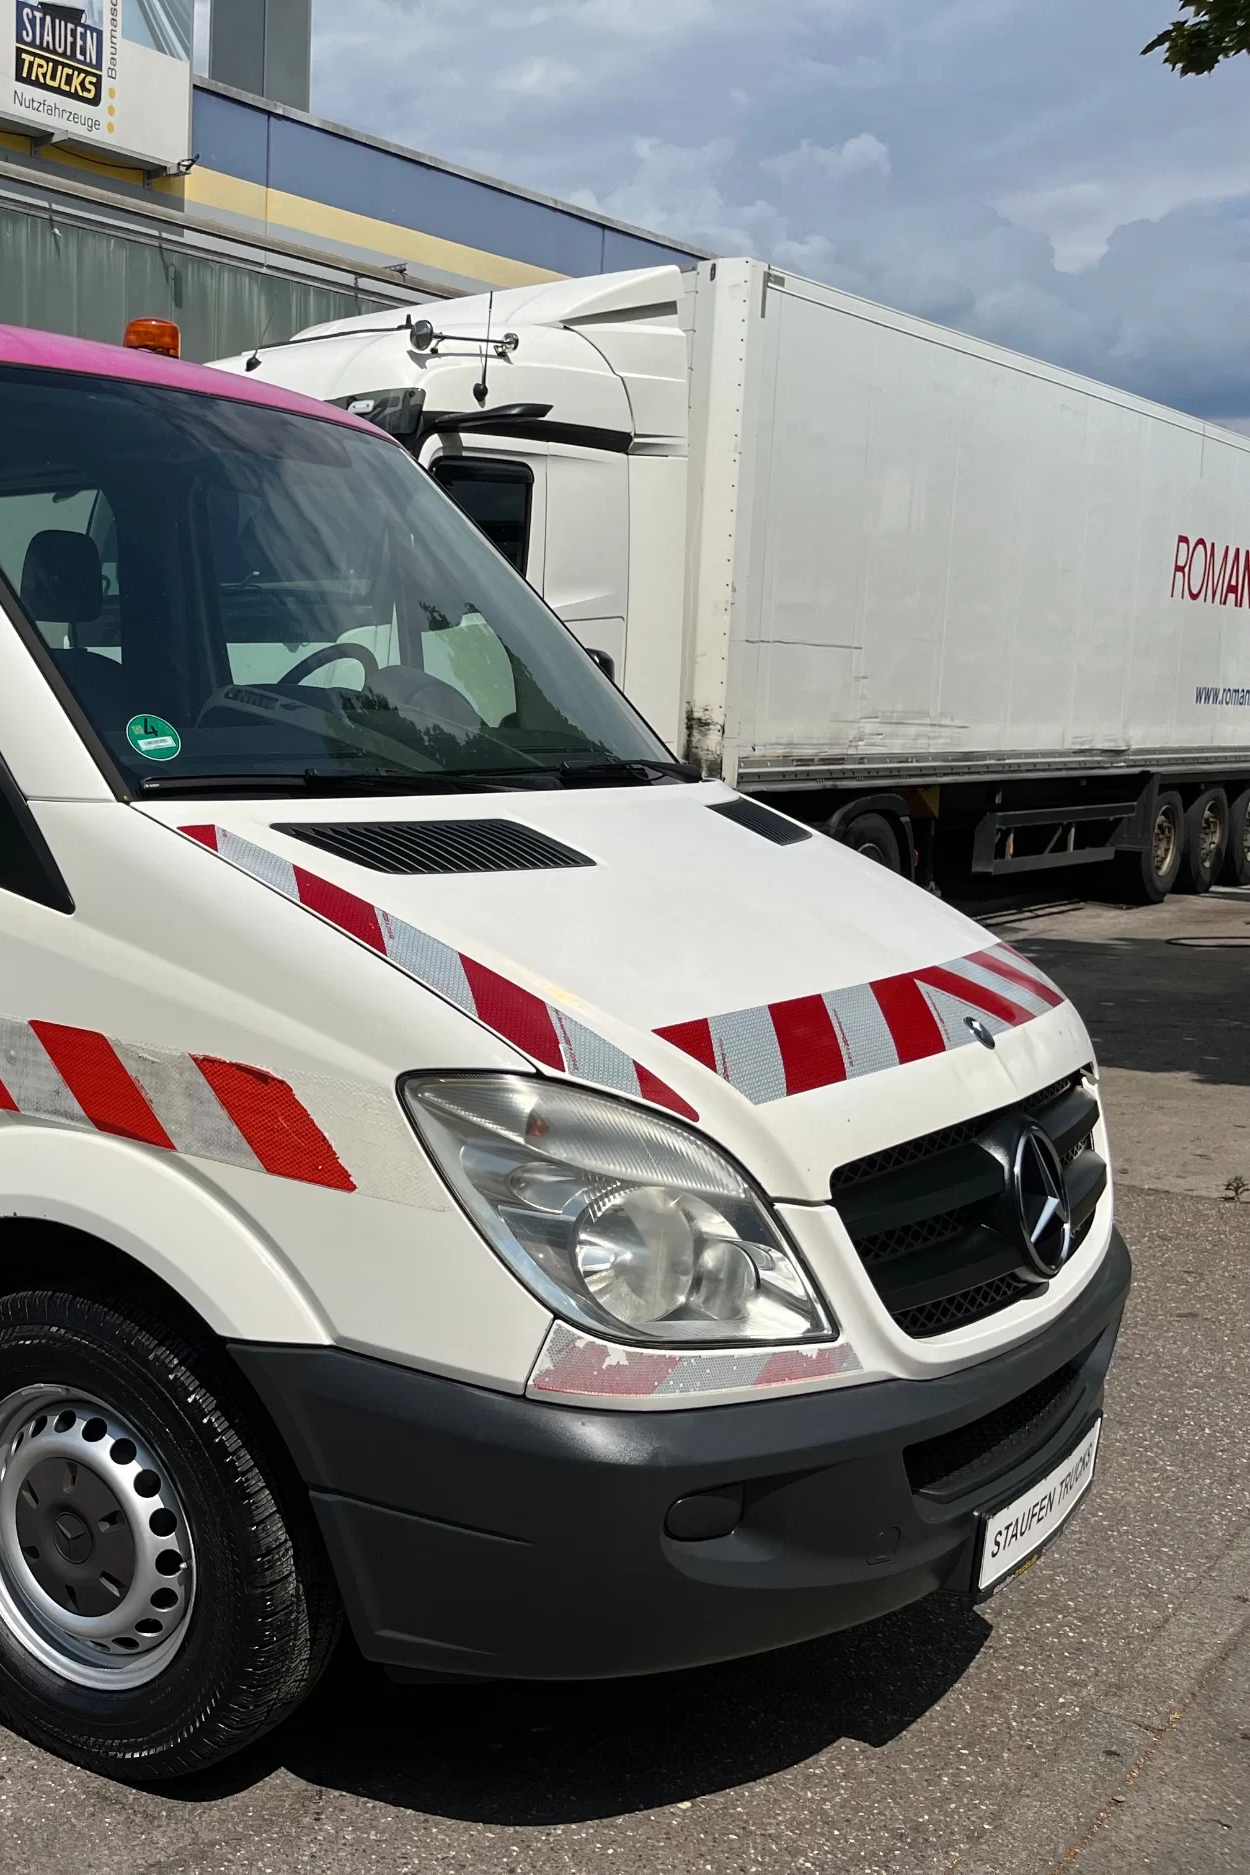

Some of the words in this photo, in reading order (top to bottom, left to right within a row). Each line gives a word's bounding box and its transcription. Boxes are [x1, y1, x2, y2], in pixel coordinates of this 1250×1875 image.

[22, 7, 97, 65] STAUFEN
[21, 53, 97, 99] TRUCKS
[13, 90, 101, 132] Nutzfahrzeuge
[144, 718, 159, 737] 4
[991, 1487, 1056, 1558] STAUFEN
[1058, 1442, 1092, 1505] TRUCKS
